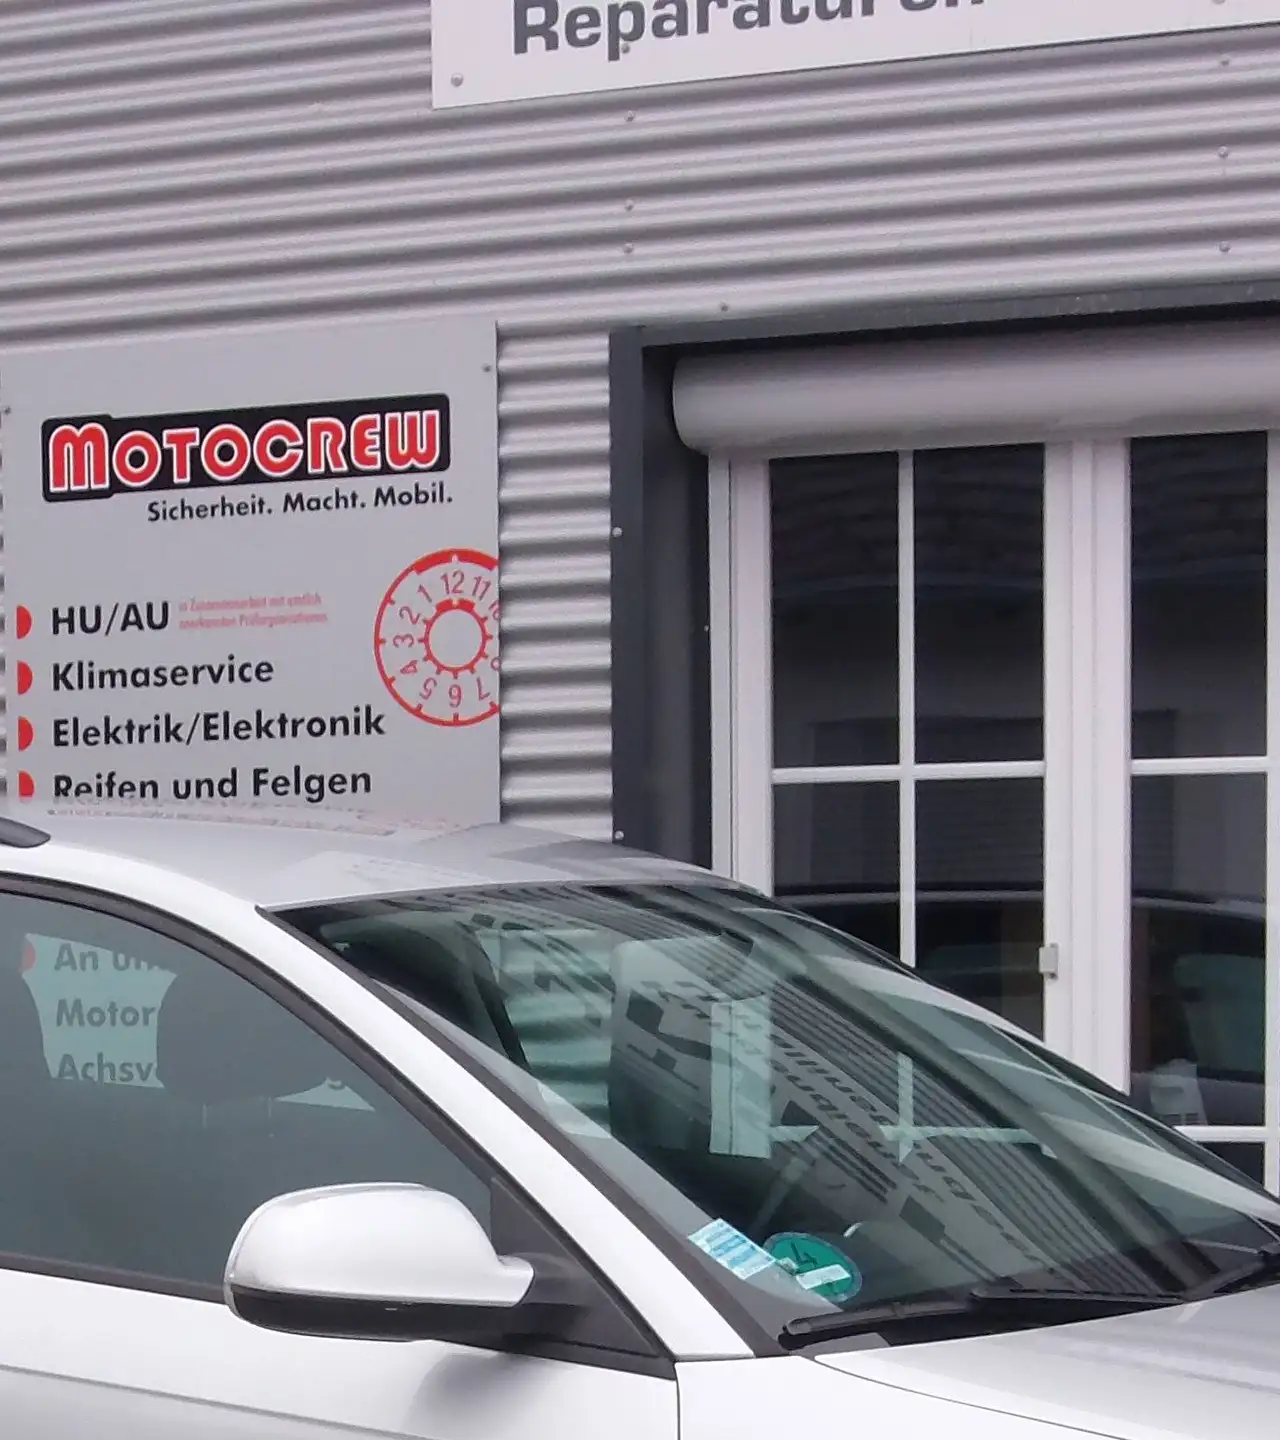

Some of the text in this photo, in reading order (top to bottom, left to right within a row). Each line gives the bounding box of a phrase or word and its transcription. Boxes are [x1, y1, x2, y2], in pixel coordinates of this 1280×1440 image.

[49, 410, 441, 493] MOTOCREW
[148, 481, 453, 521] Sicherheit. Macht. Mobil.
[440, 570, 465, 595] 12
[52, 600, 169, 636] HU/AU
[53, 653, 274, 691] Klimaservice
[53, 704, 385, 747] Elektrik/Elektronik
[53, 764, 372, 803] Reifen und Felgen
[54, 942, 99, 971] An
[56, 998, 156, 1027] Motor
[57, 1052, 157, 1083] Achsv
